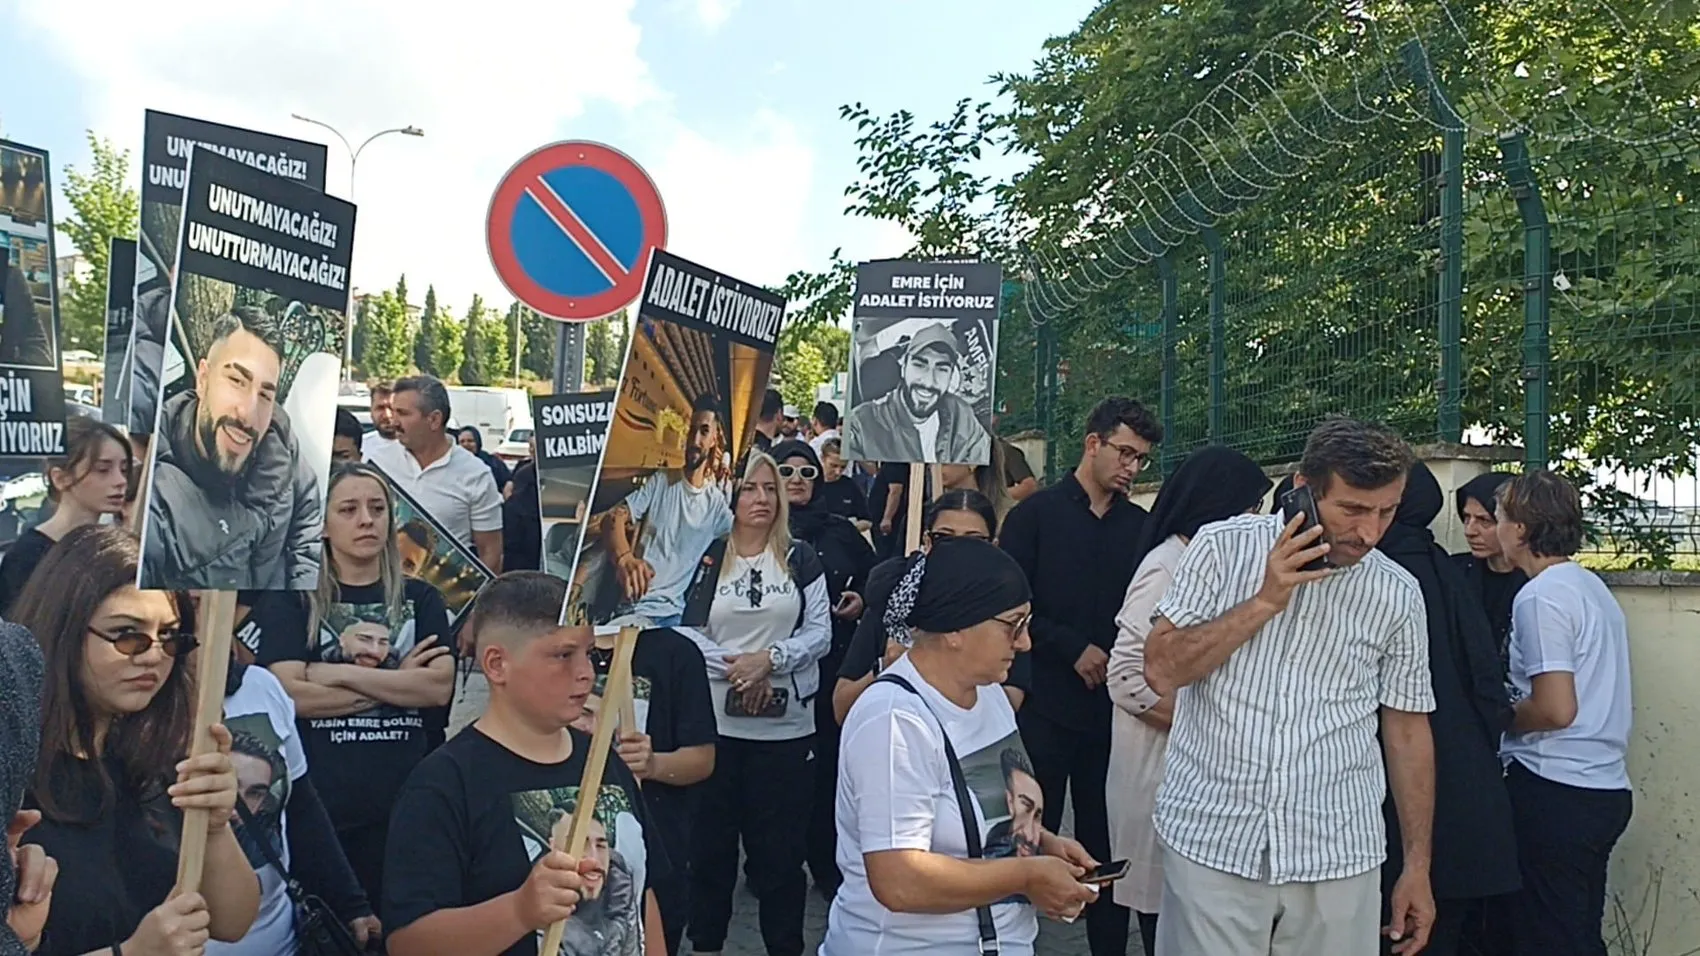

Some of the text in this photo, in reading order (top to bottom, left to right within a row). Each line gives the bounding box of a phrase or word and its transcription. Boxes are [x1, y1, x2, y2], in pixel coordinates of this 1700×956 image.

[209, 183, 338, 249] UNUTMAYACAĞIZ!
[188, 221, 346, 291] UNUTTURMAYACAĞIZ!
[891, 273, 965, 292] EMRE İÇİN
[648, 263, 783, 344] ADALET İSTİYORUZ!
[859, 292, 995, 309] ADALET İSTİYORUZ
[0, 370, 32, 420] ÇİN
[545, 428, 608, 458] KALBİM
[330, 729, 357, 743] İÇİN
[359, 731, 403, 741] ADALET
[347, 717, 380, 728] EMRE
